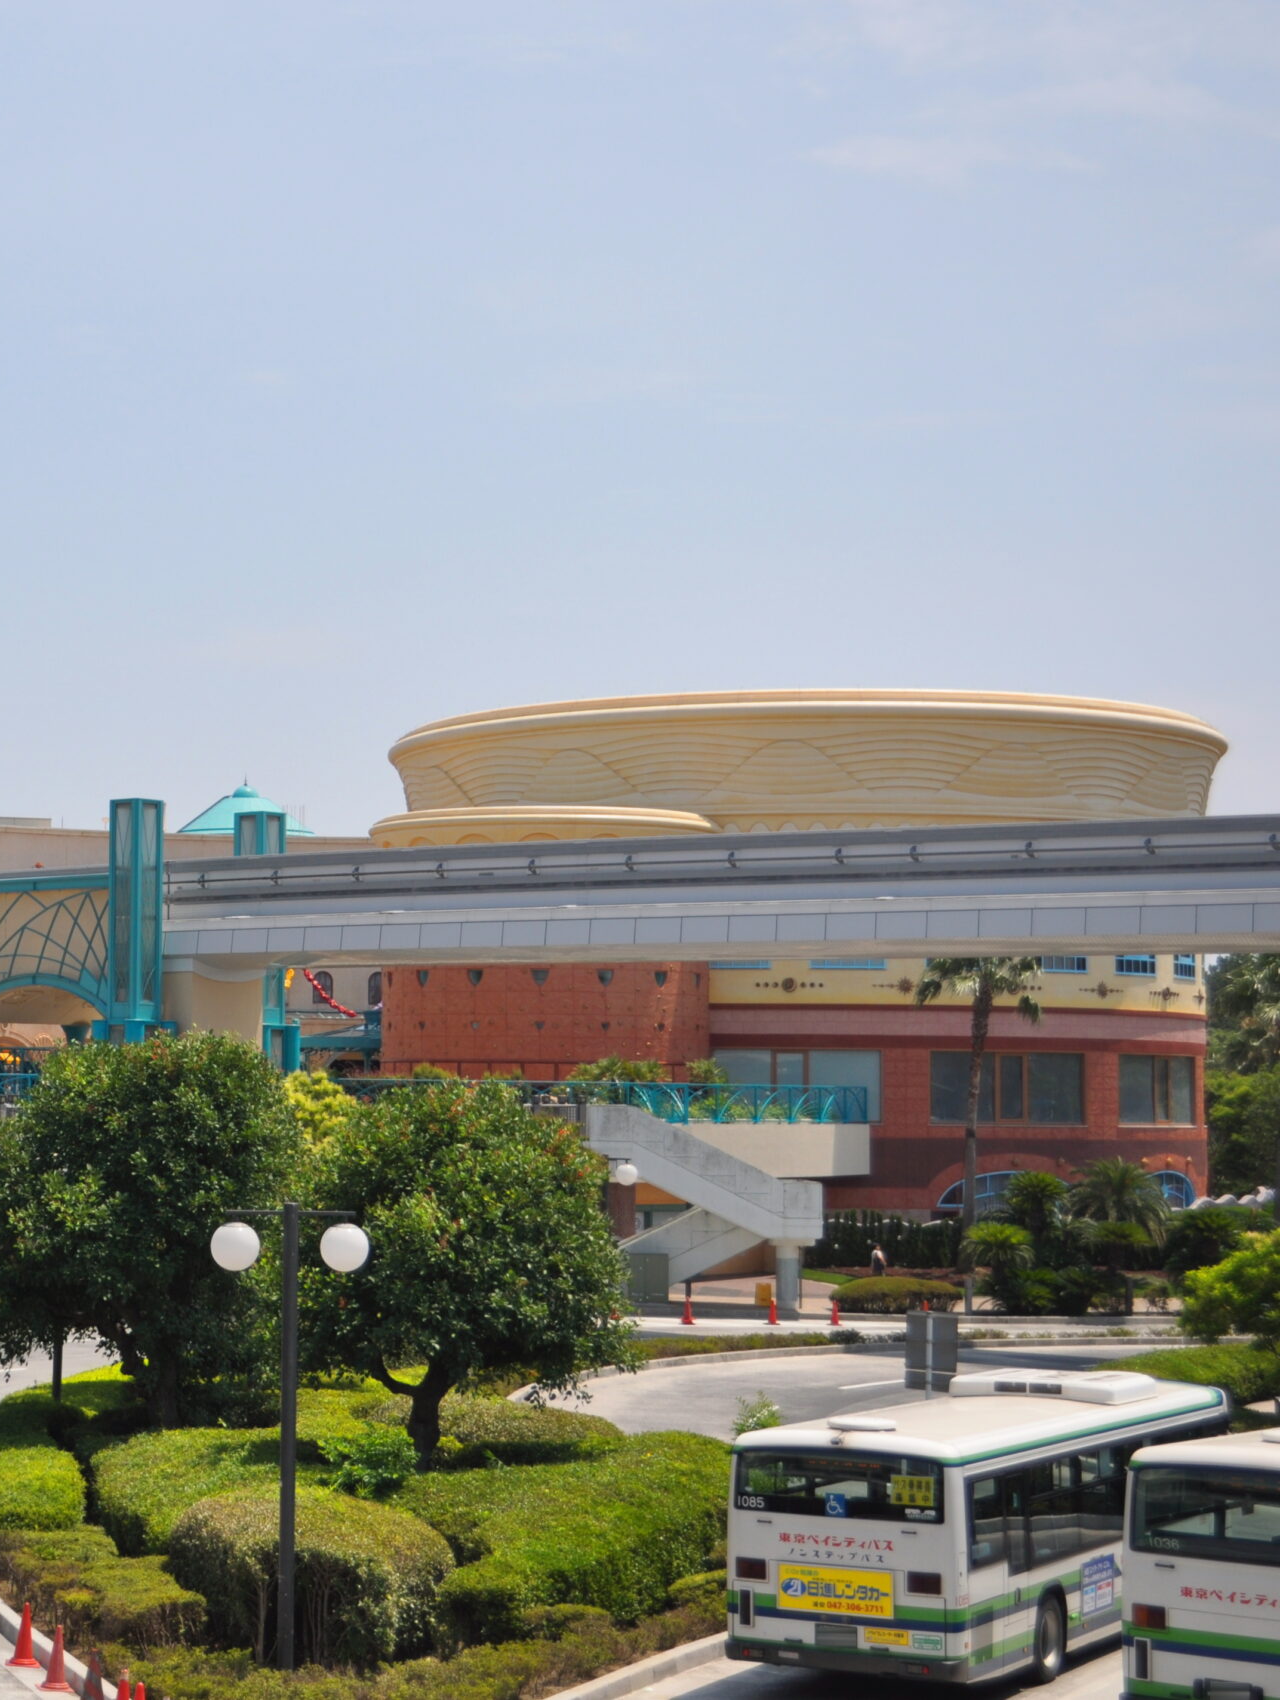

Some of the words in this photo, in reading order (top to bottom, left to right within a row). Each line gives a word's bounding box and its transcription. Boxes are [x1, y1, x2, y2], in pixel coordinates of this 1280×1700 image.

[737, 1495, 765, 1508] 1085
[778, 1531, 894, 1551] 東京ベイシティバス
[788, 1547, 884, 1563] ノンステップバス
[807, 1580, 889, 1601] 日進レンタカー
